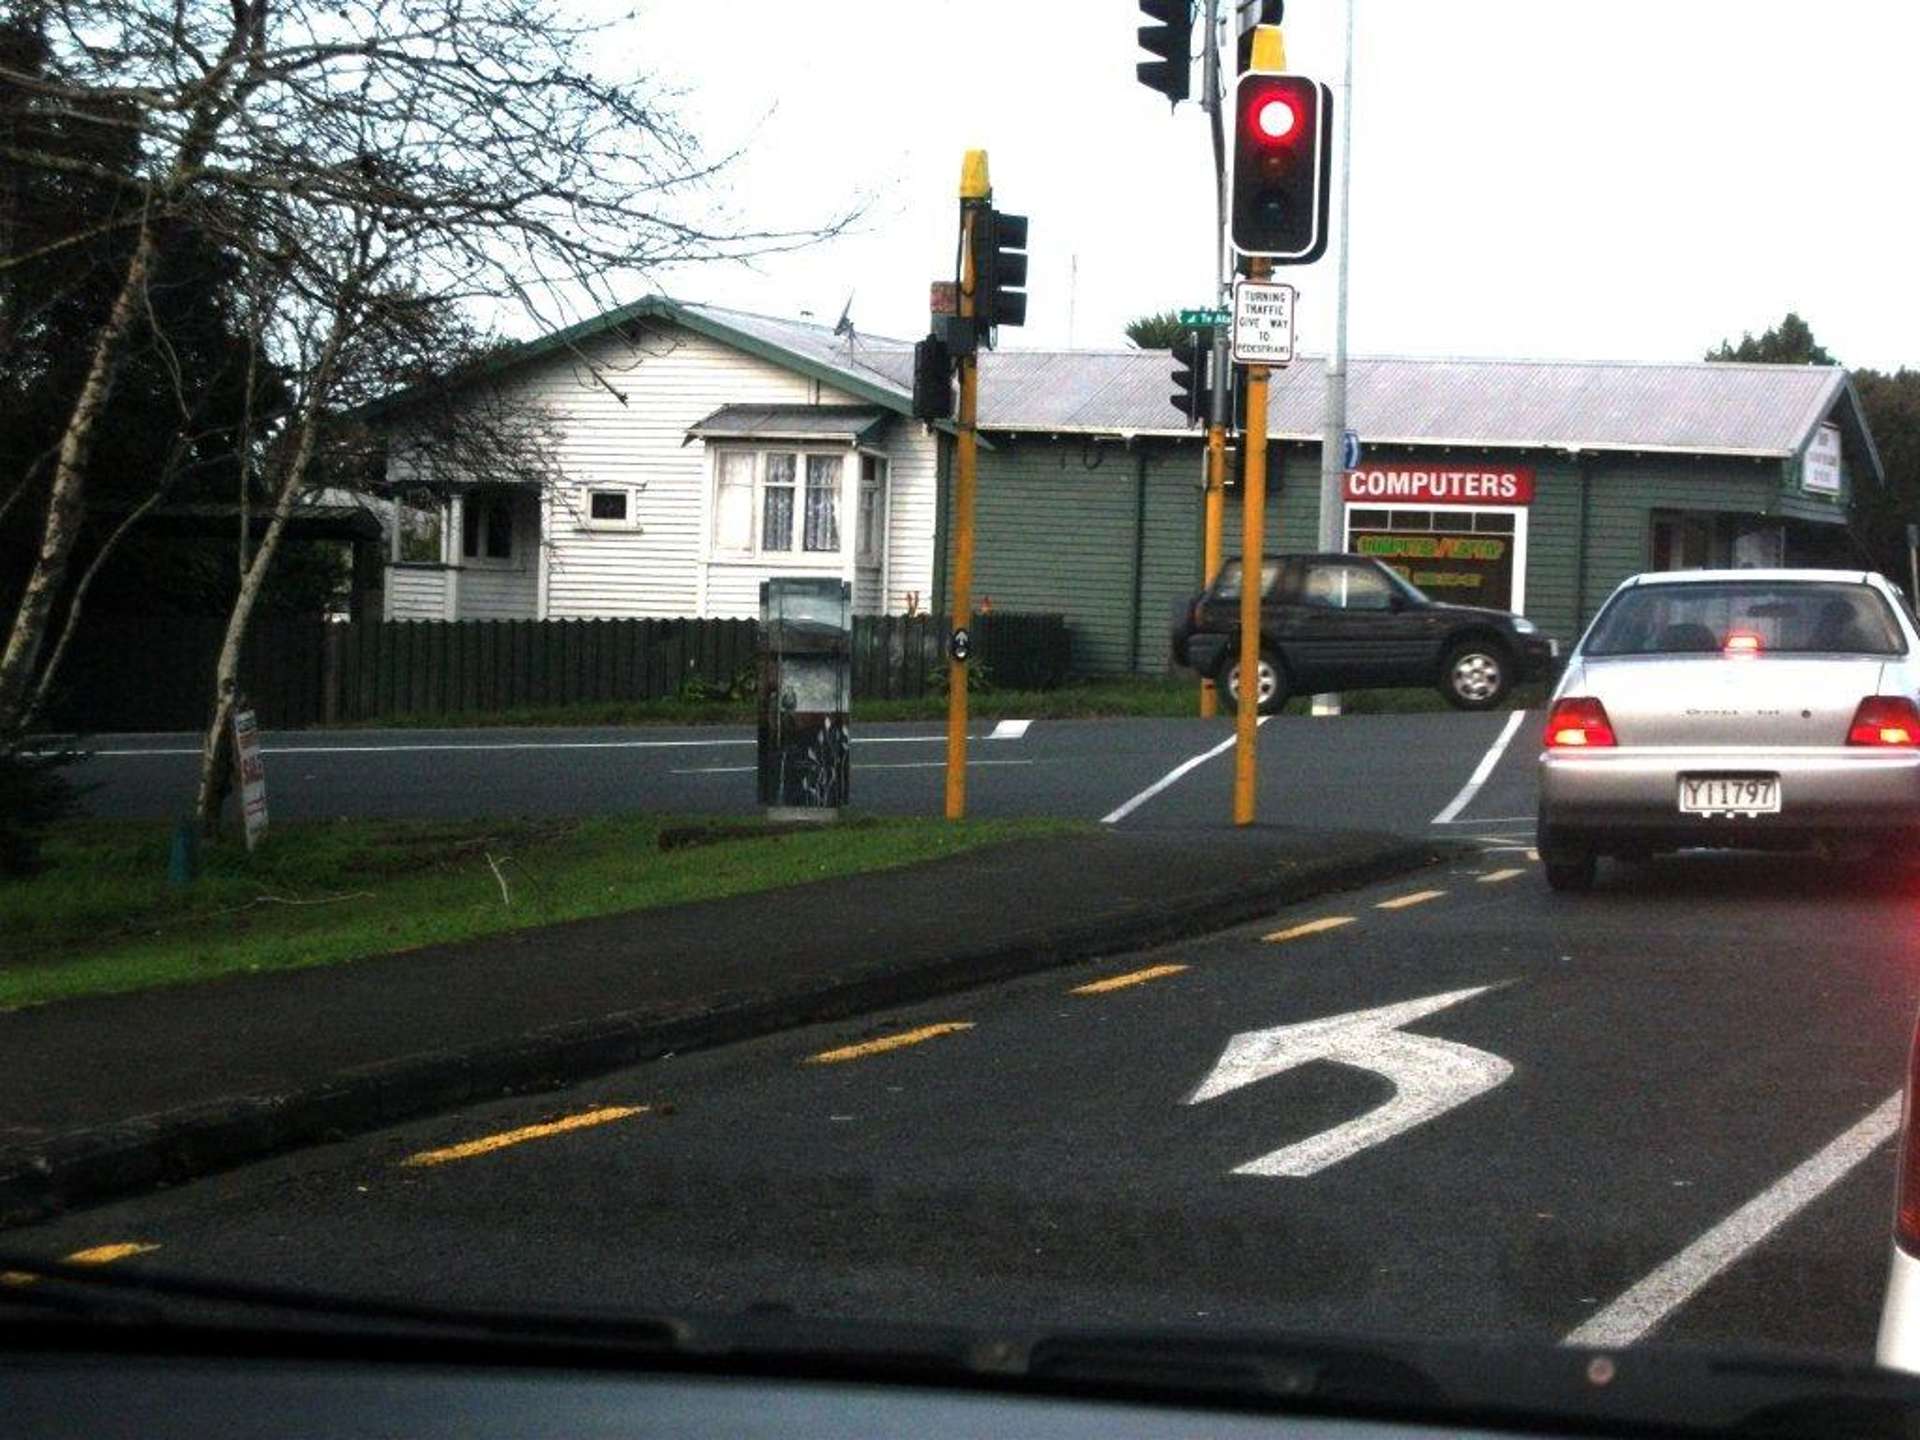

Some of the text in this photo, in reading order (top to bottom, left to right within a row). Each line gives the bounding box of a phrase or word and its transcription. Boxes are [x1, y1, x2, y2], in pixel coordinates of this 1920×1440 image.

[1244, 291, 1286, 303] TURNING
[1245, 304, 1285, 316] TRAFFIC
[1239, 316, 1260, 328] GIVE
[1270, 318, 1289, 329] WAY
[1259, 331, 1270, 342] TO
[1349, 471, 1518, 497] COMPUTERS
